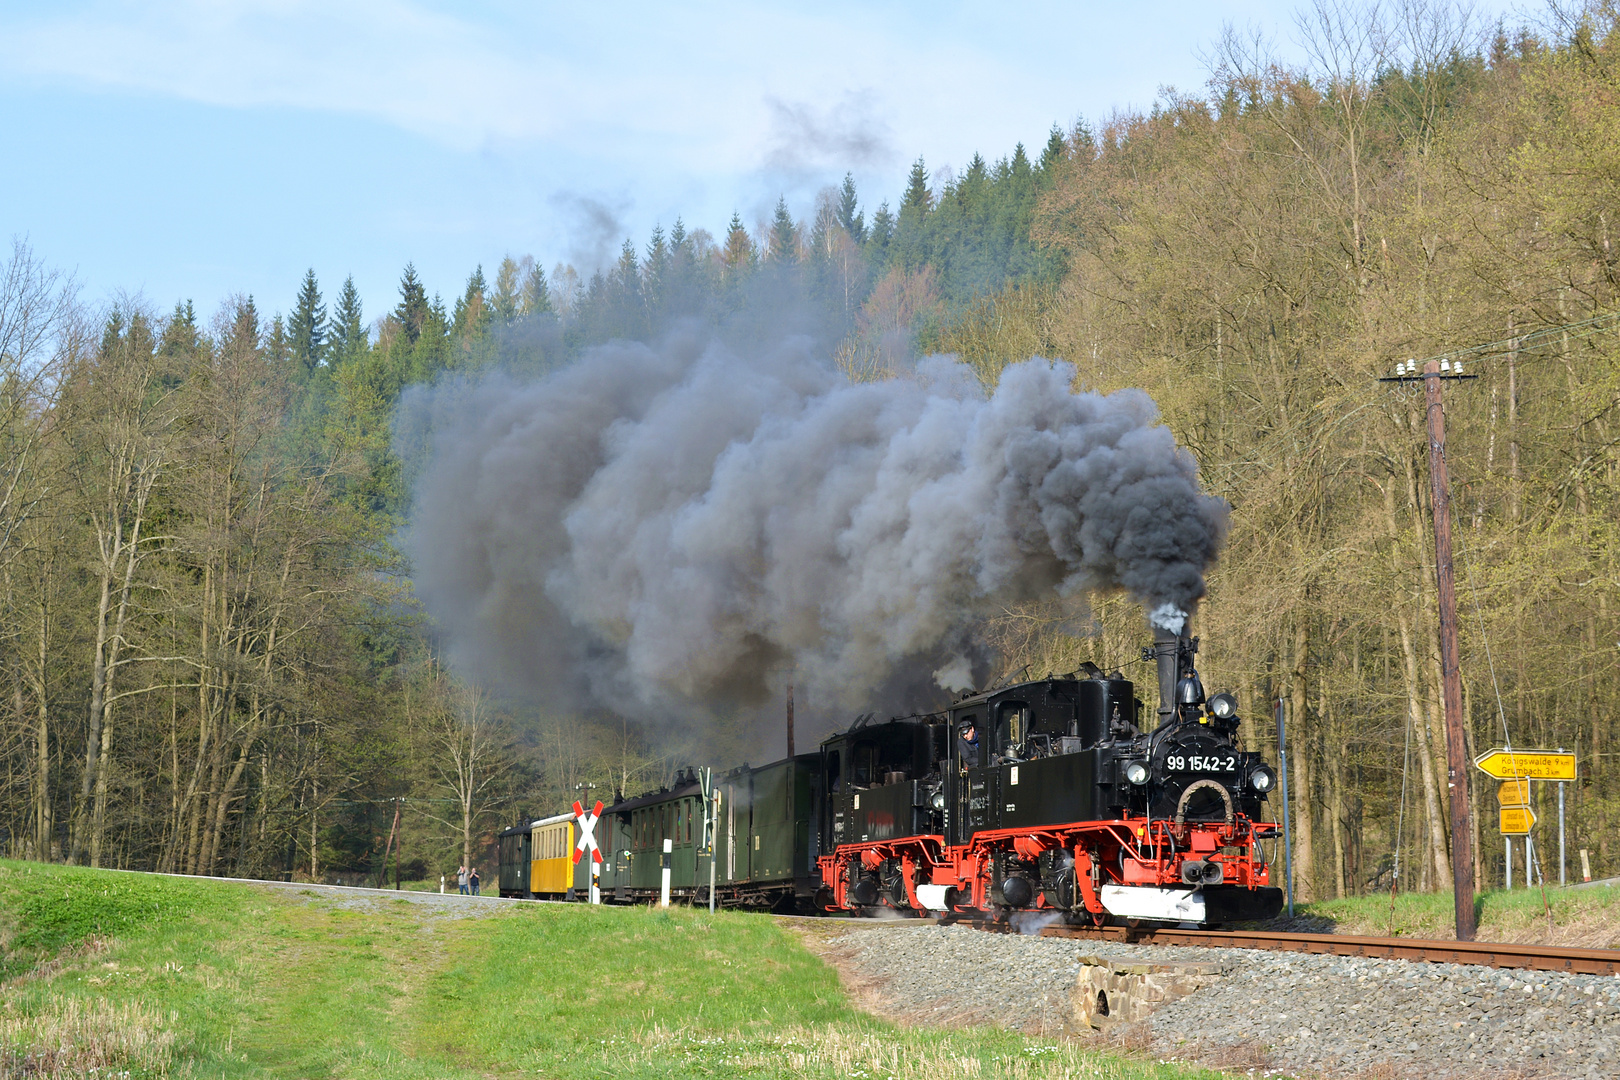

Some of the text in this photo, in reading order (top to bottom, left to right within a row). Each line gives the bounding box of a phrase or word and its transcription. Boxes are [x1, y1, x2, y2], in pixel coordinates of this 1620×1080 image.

[1167, 755, 1235, 771] 99 1542-2
[1502, 756, 1552, 766] Königswalde
[1501, 766, 1542, 775] Grumbach
[1545, 767, 1550, 775] 3
